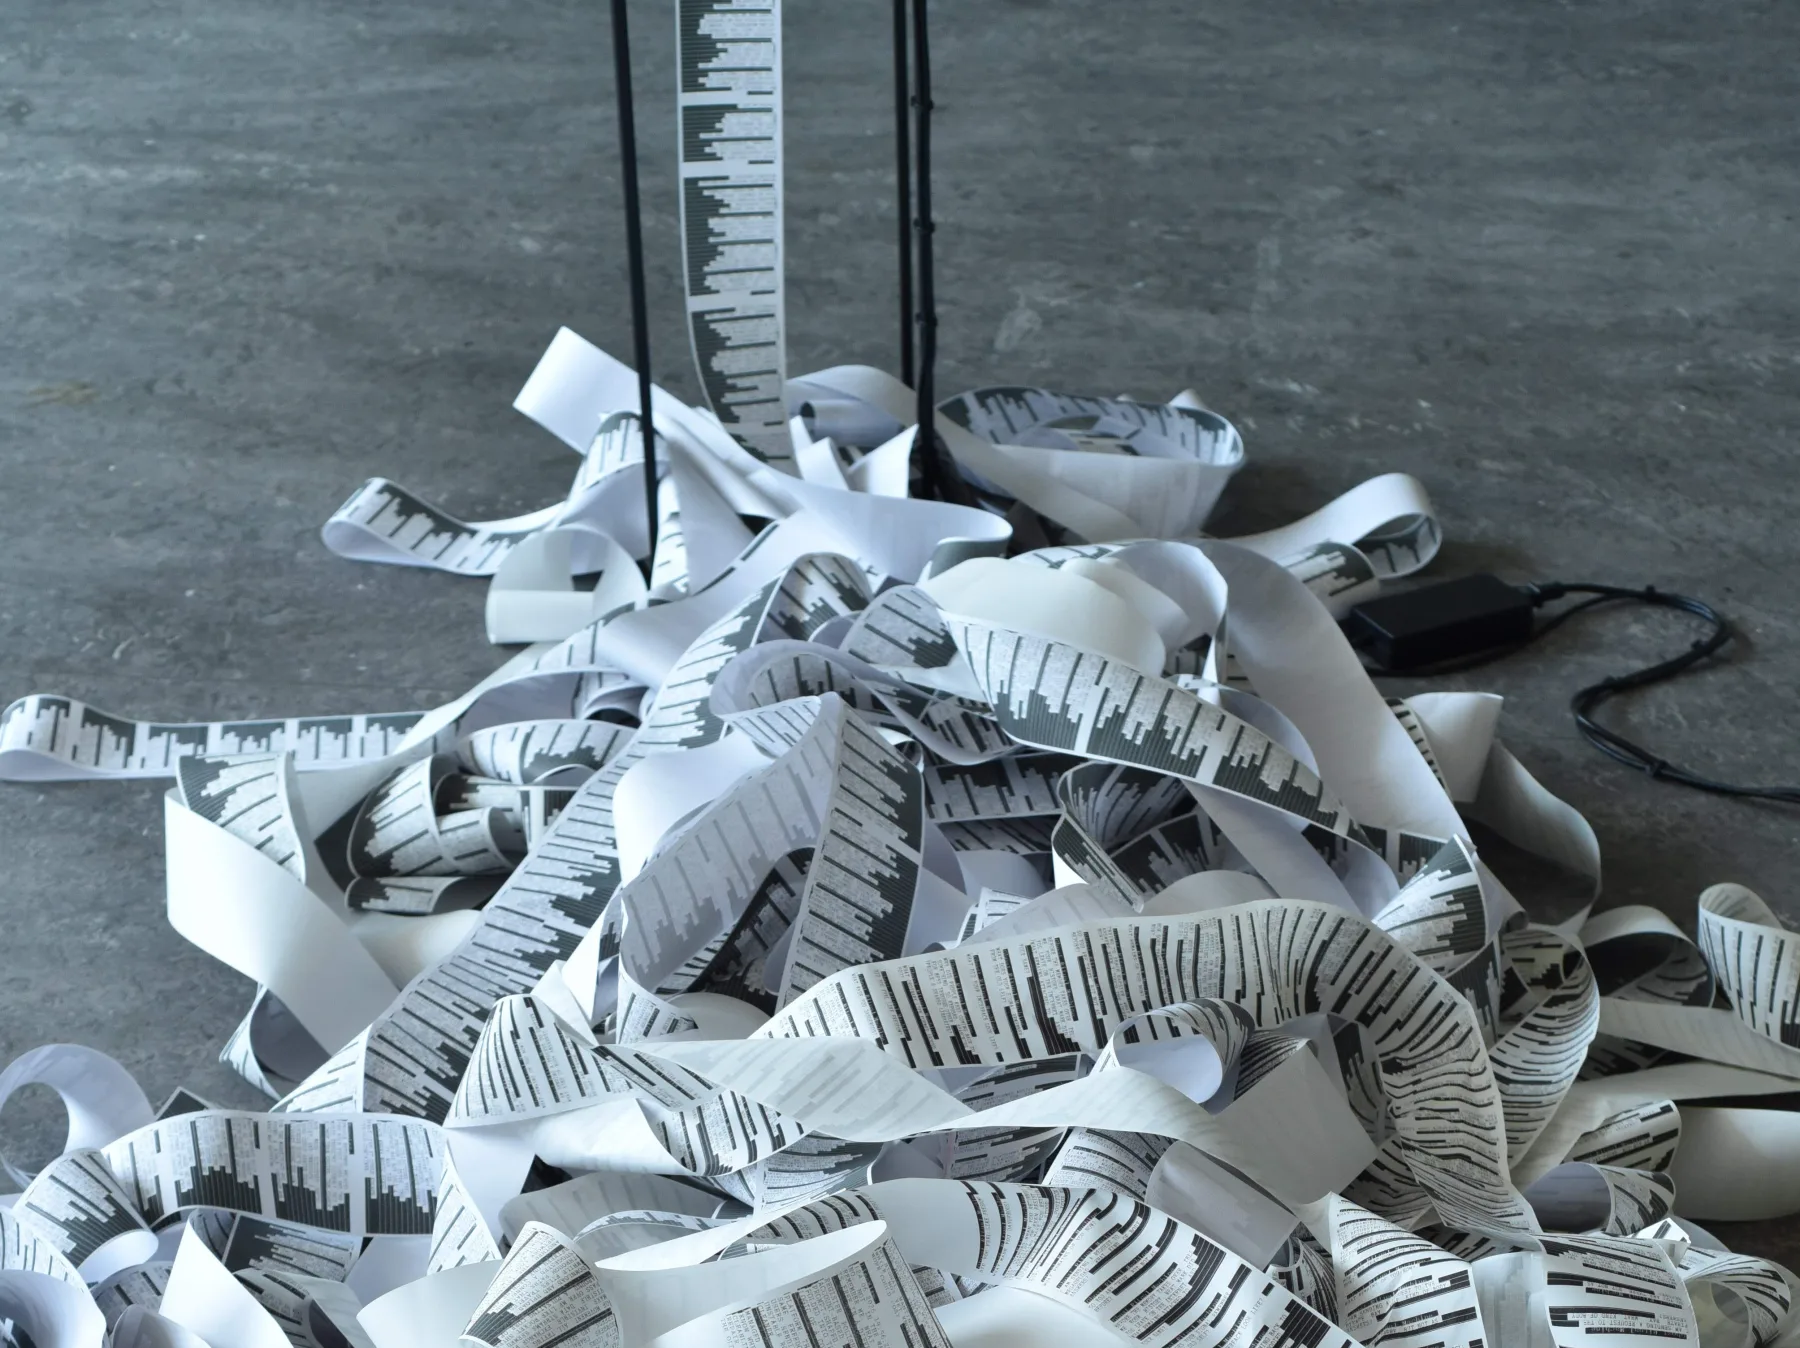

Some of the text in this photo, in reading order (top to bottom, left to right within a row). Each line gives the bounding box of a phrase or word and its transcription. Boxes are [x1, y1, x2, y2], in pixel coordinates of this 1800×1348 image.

[542, 1284, 555, 1295] AND
[558, 1302, 575, 1316] DATA
[776, 1296, 789, 1315] SAME
